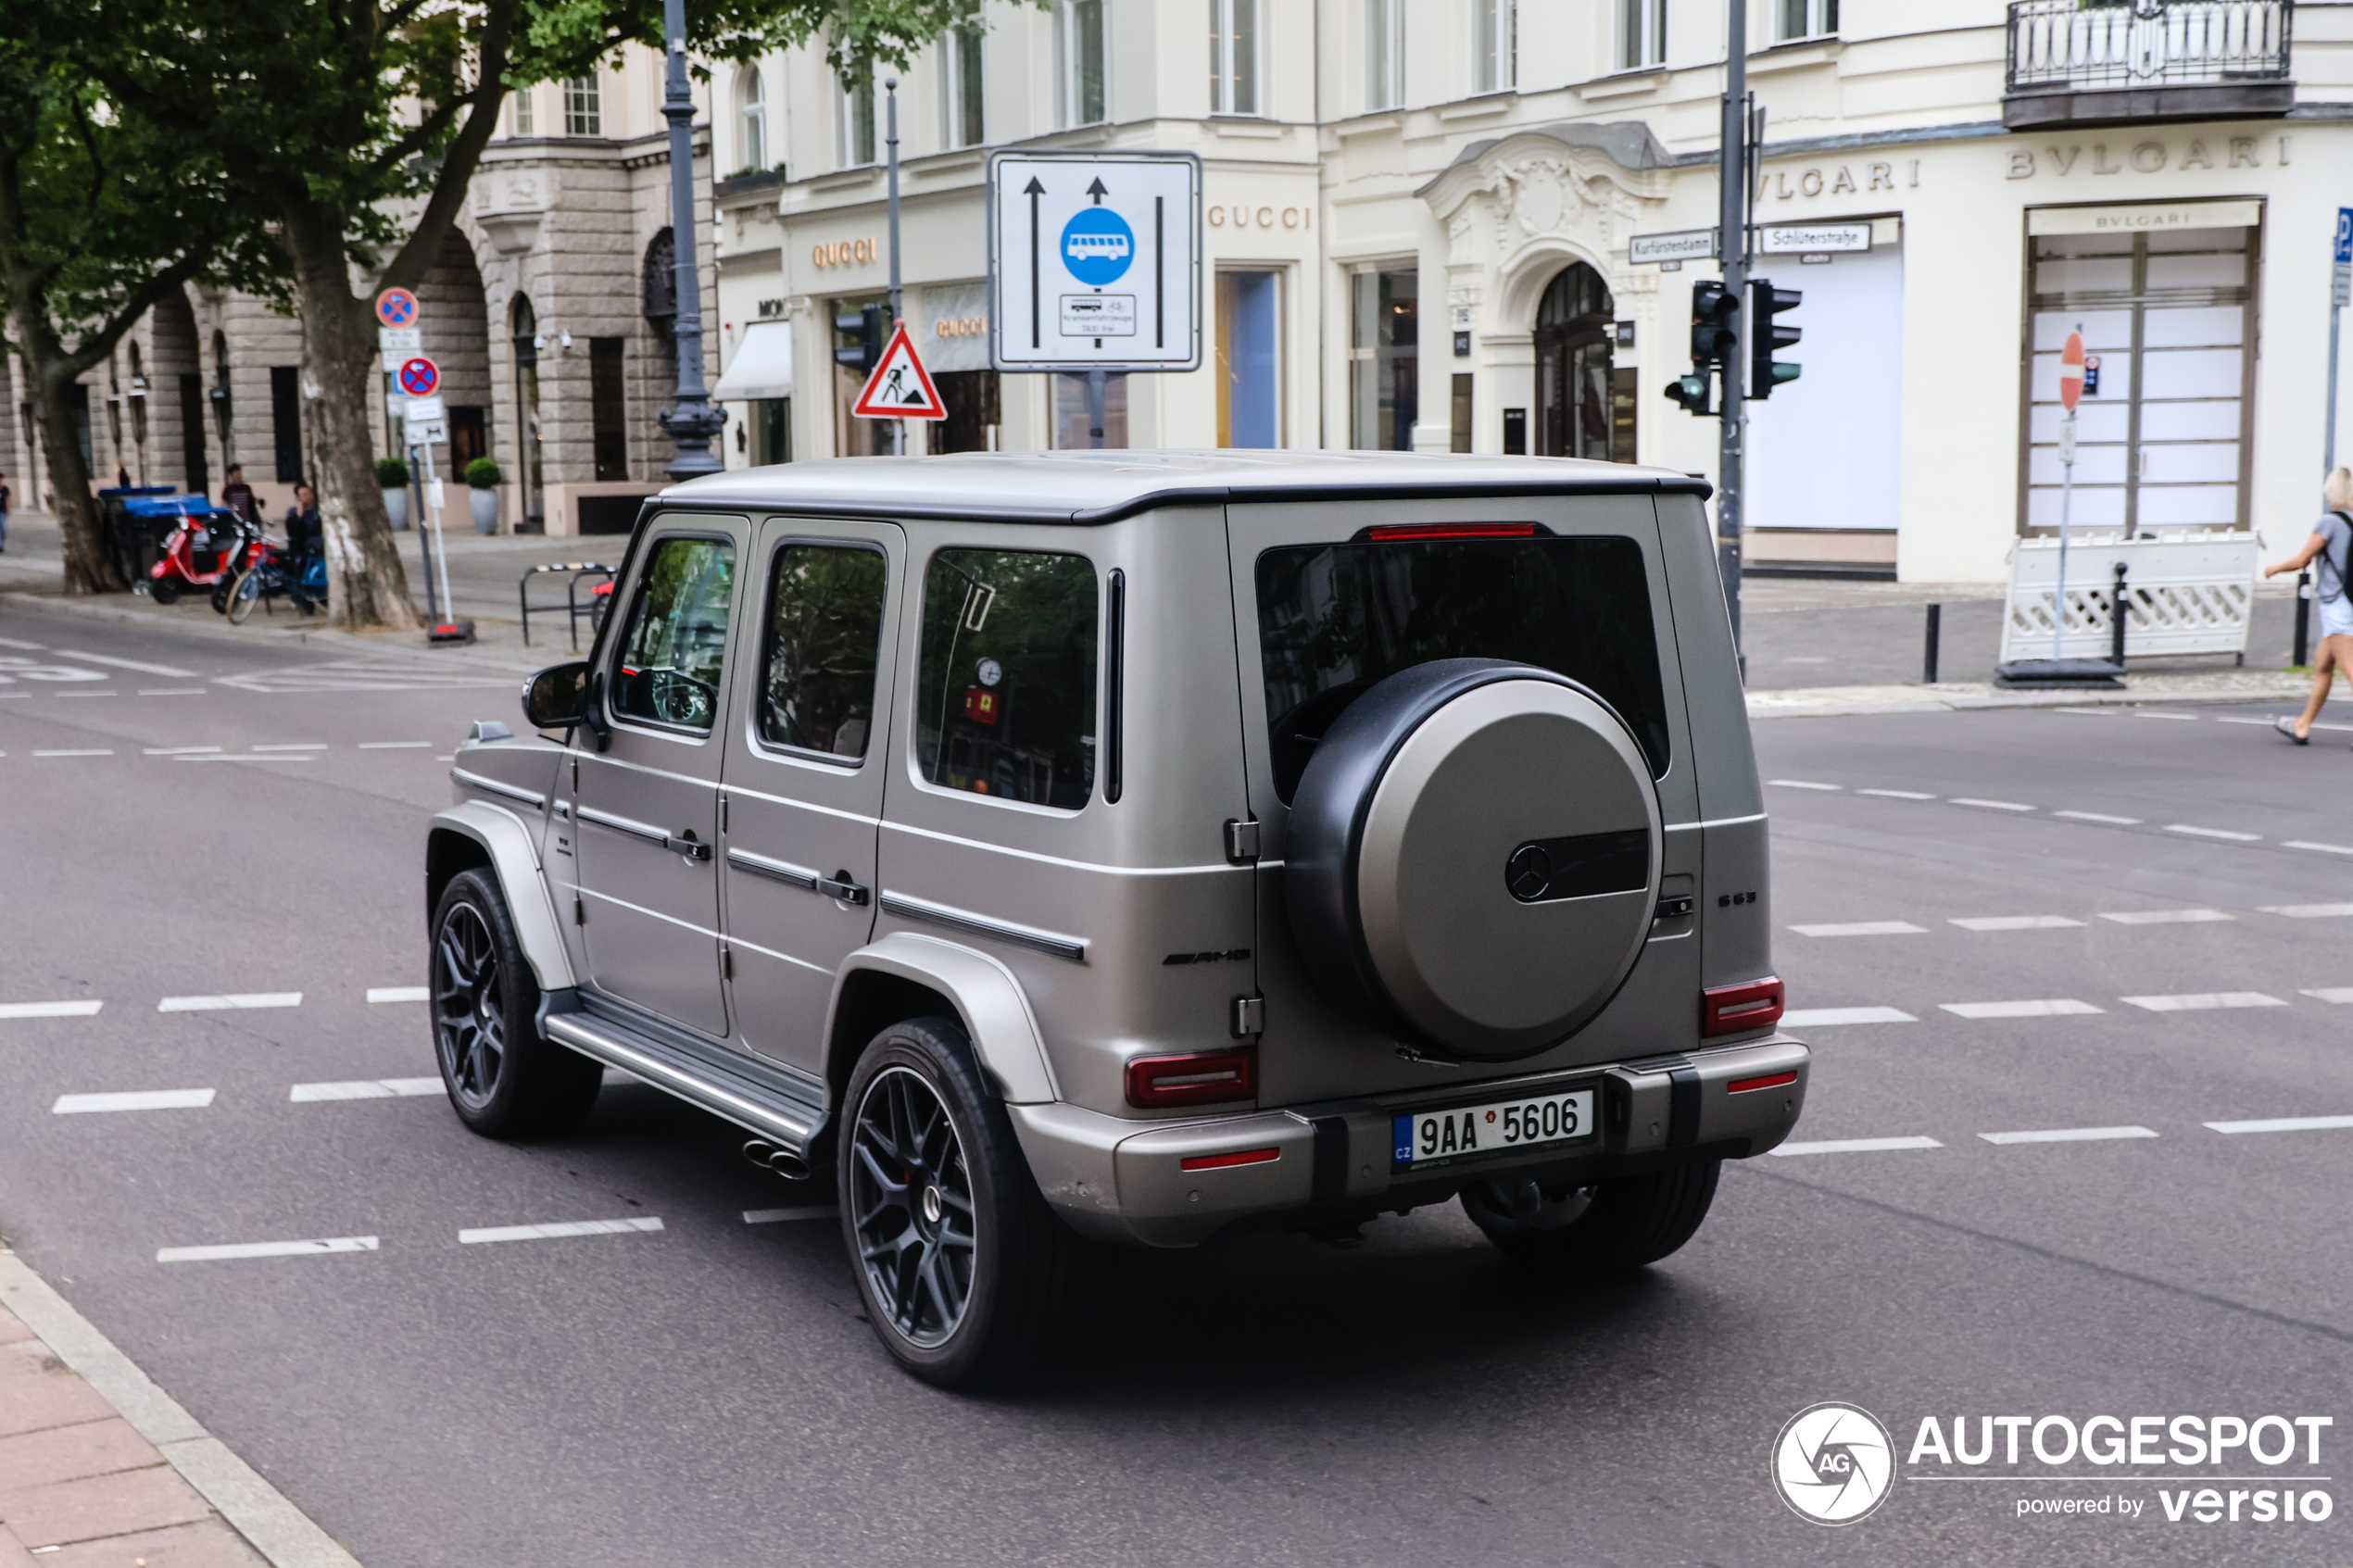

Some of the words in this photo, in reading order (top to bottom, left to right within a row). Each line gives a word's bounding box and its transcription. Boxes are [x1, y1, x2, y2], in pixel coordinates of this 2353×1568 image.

[2006, 137, 2292, 181] BVLGARI
[1207, 206, 1311, 230] GUCCI
[2096, 214, 2190, 228] BVLGARI
[1634, 238, 1709, 256] Kurfürstendamm
[1773, 231, 1858, 247] Schlüterstraße
[813, 237, 876, 270] GUCCI
[937, 318, 987, 338] GUCCI
[1421, 1112, 1477, 1155] 9AA
[1504, 1098, 1578, 1142] 5606
[1396, 1147, 1411, 1160] CZ
